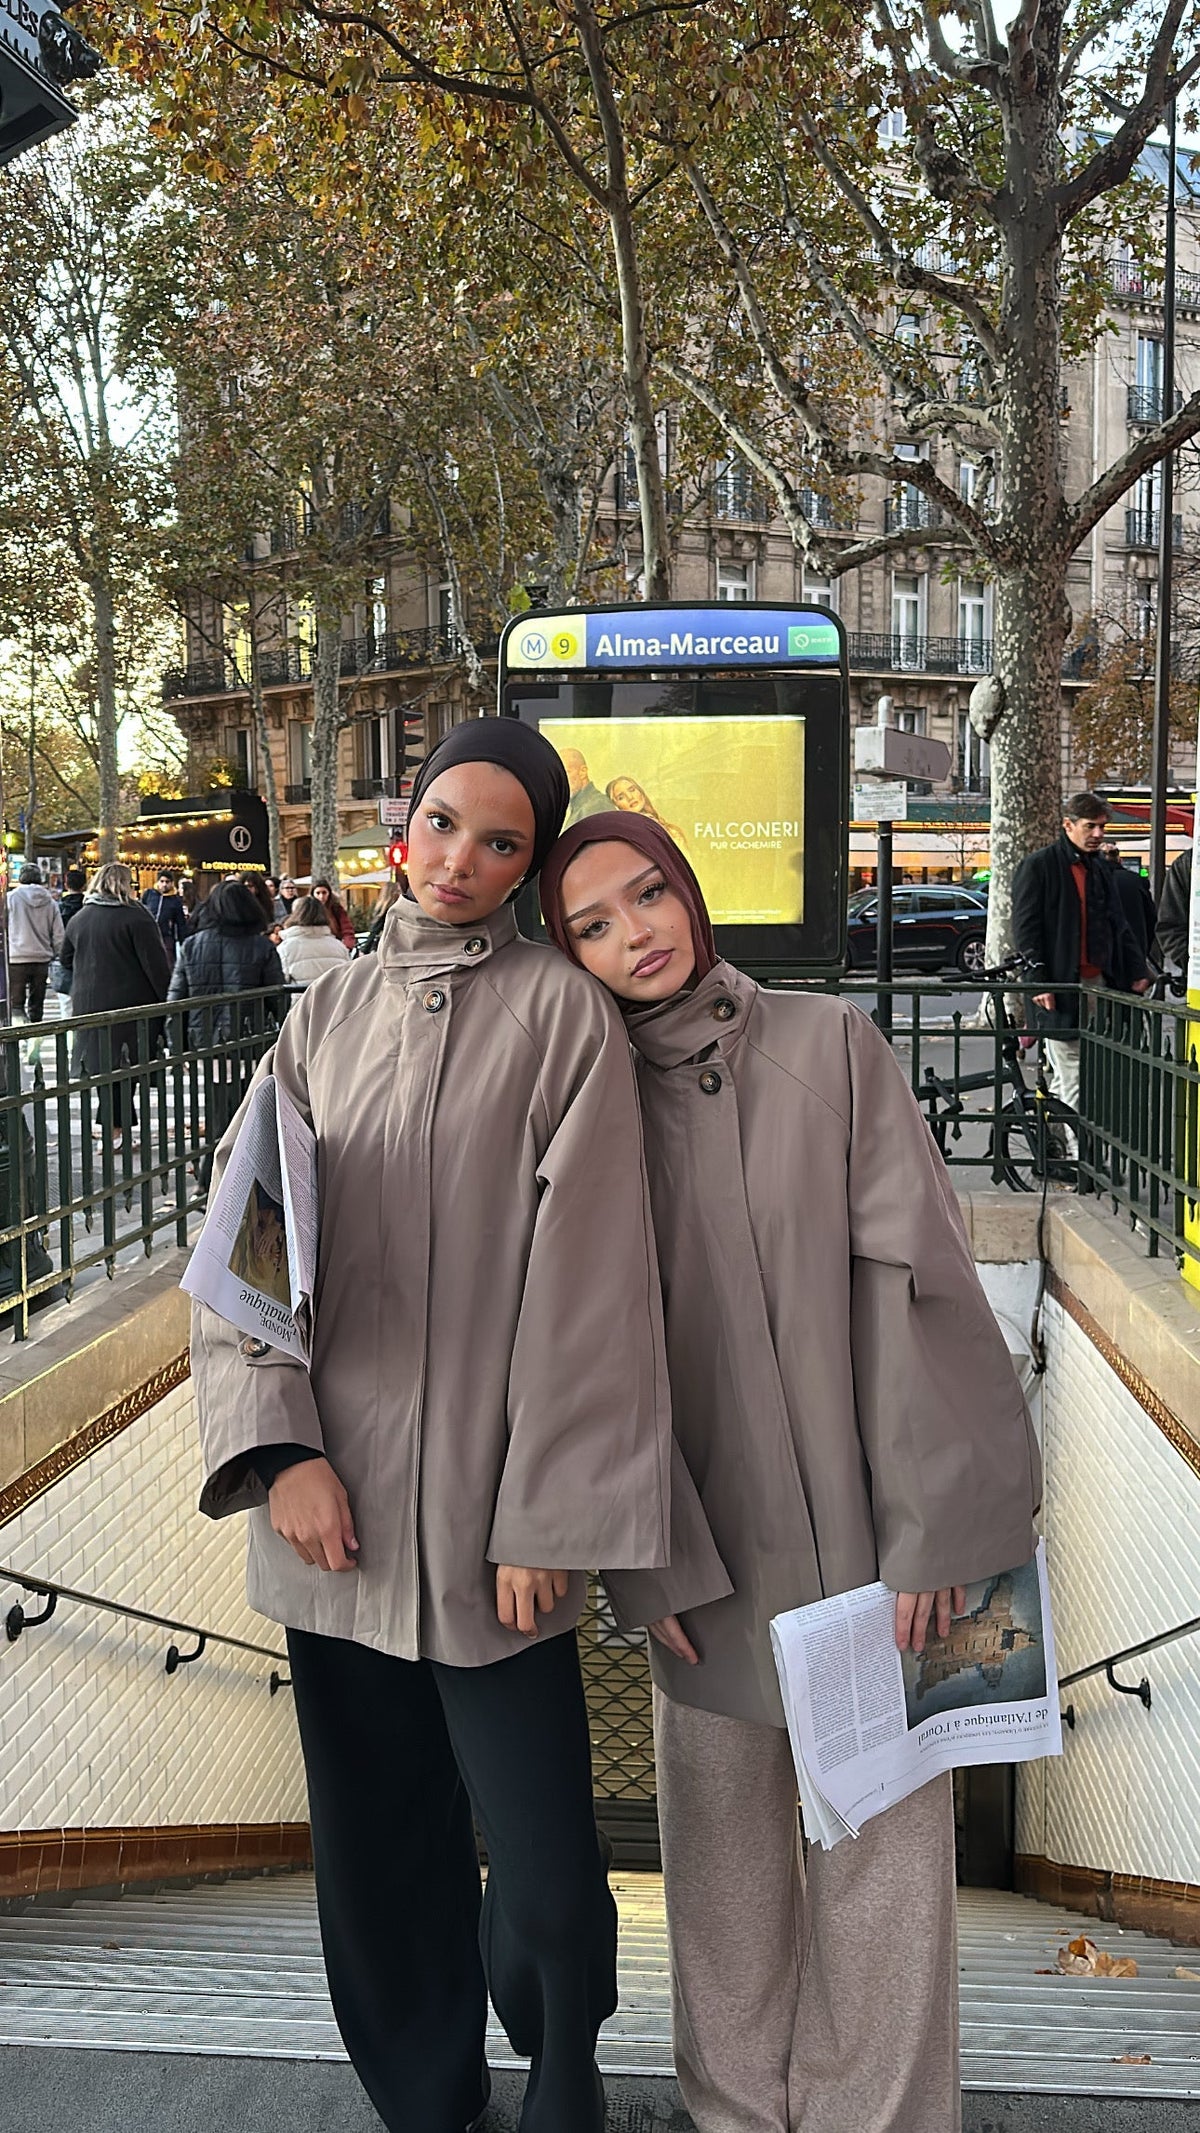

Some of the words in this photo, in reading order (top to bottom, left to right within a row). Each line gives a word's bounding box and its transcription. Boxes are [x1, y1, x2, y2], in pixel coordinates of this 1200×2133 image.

[527, 639, 541, 654] M
[559, 638, 570, 655] 9
[595, 633, 780, 657] Alma-Marceau
[694, 821, 799, 838] FALCONERI
[710, 841, 728, 850] PUR
[730, 840, 782, 850] CACHEMIRE
[261, 1316, 293, 1343] MONDE
[1035, 1708, 1049, 1721] de
[953, 1720, 961, 1731] à
